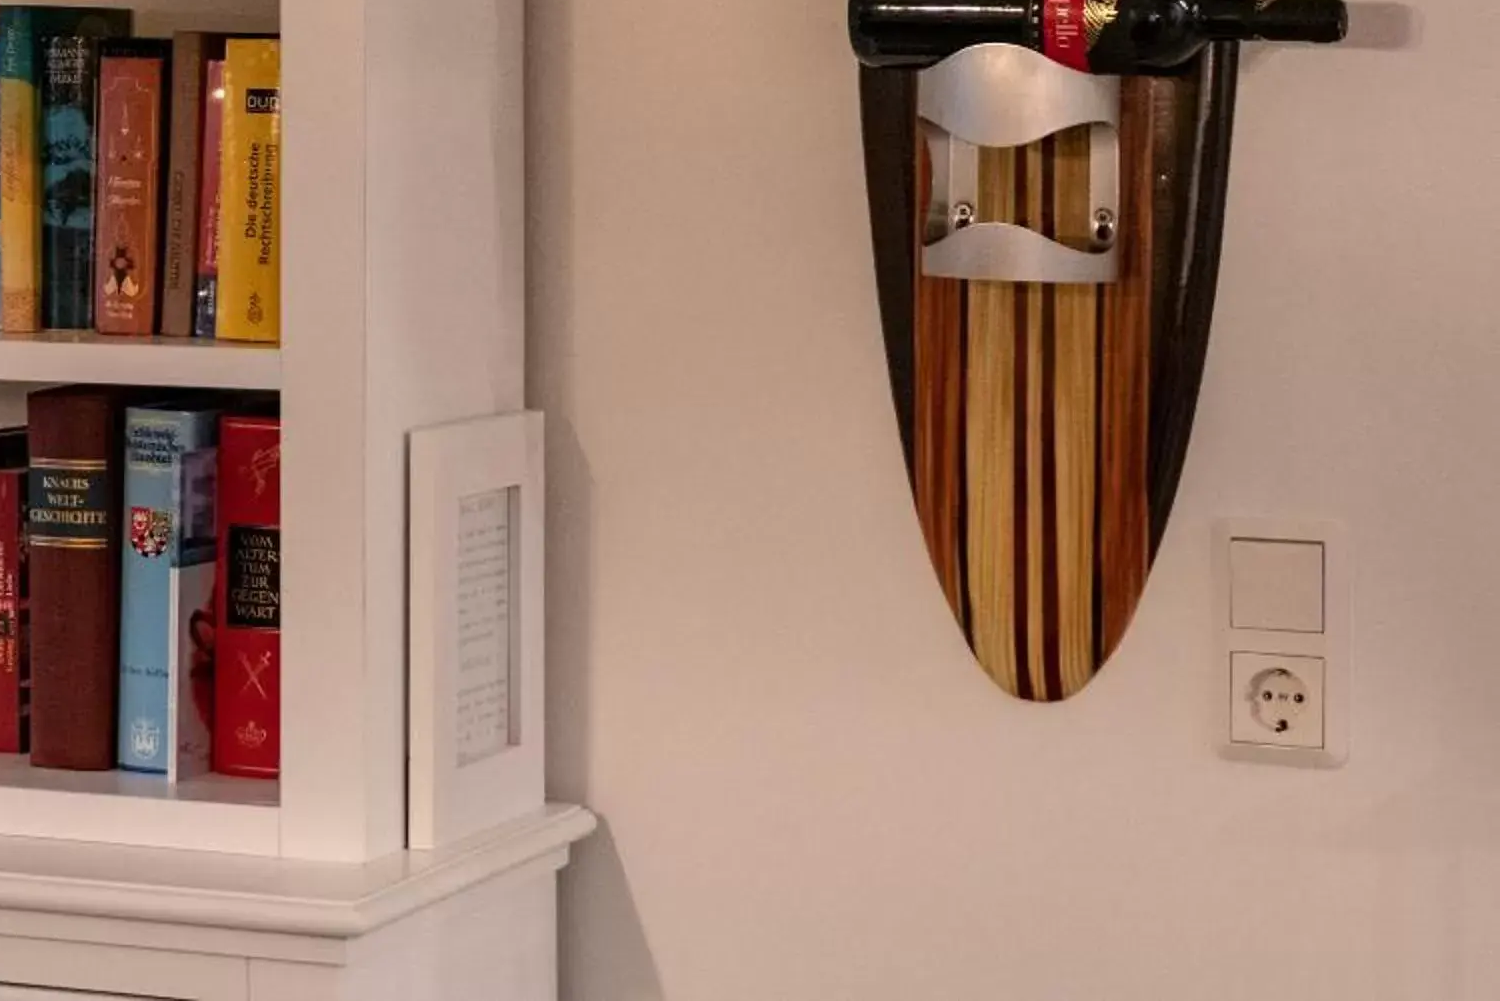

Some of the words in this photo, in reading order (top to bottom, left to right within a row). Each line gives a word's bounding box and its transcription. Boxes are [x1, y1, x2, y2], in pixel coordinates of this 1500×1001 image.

[245, 142, 260, 210] deutsche
[257, 144, 278, 265] Rechtschreibung
[244, 214, 256, 239] Die
[43, 476, 91, 490] KNAURS
[47, 494, 85, 507] WELT-
[29, 510, 108, 525] GESCHICHTE
[235, 606, 277, 620] WART
